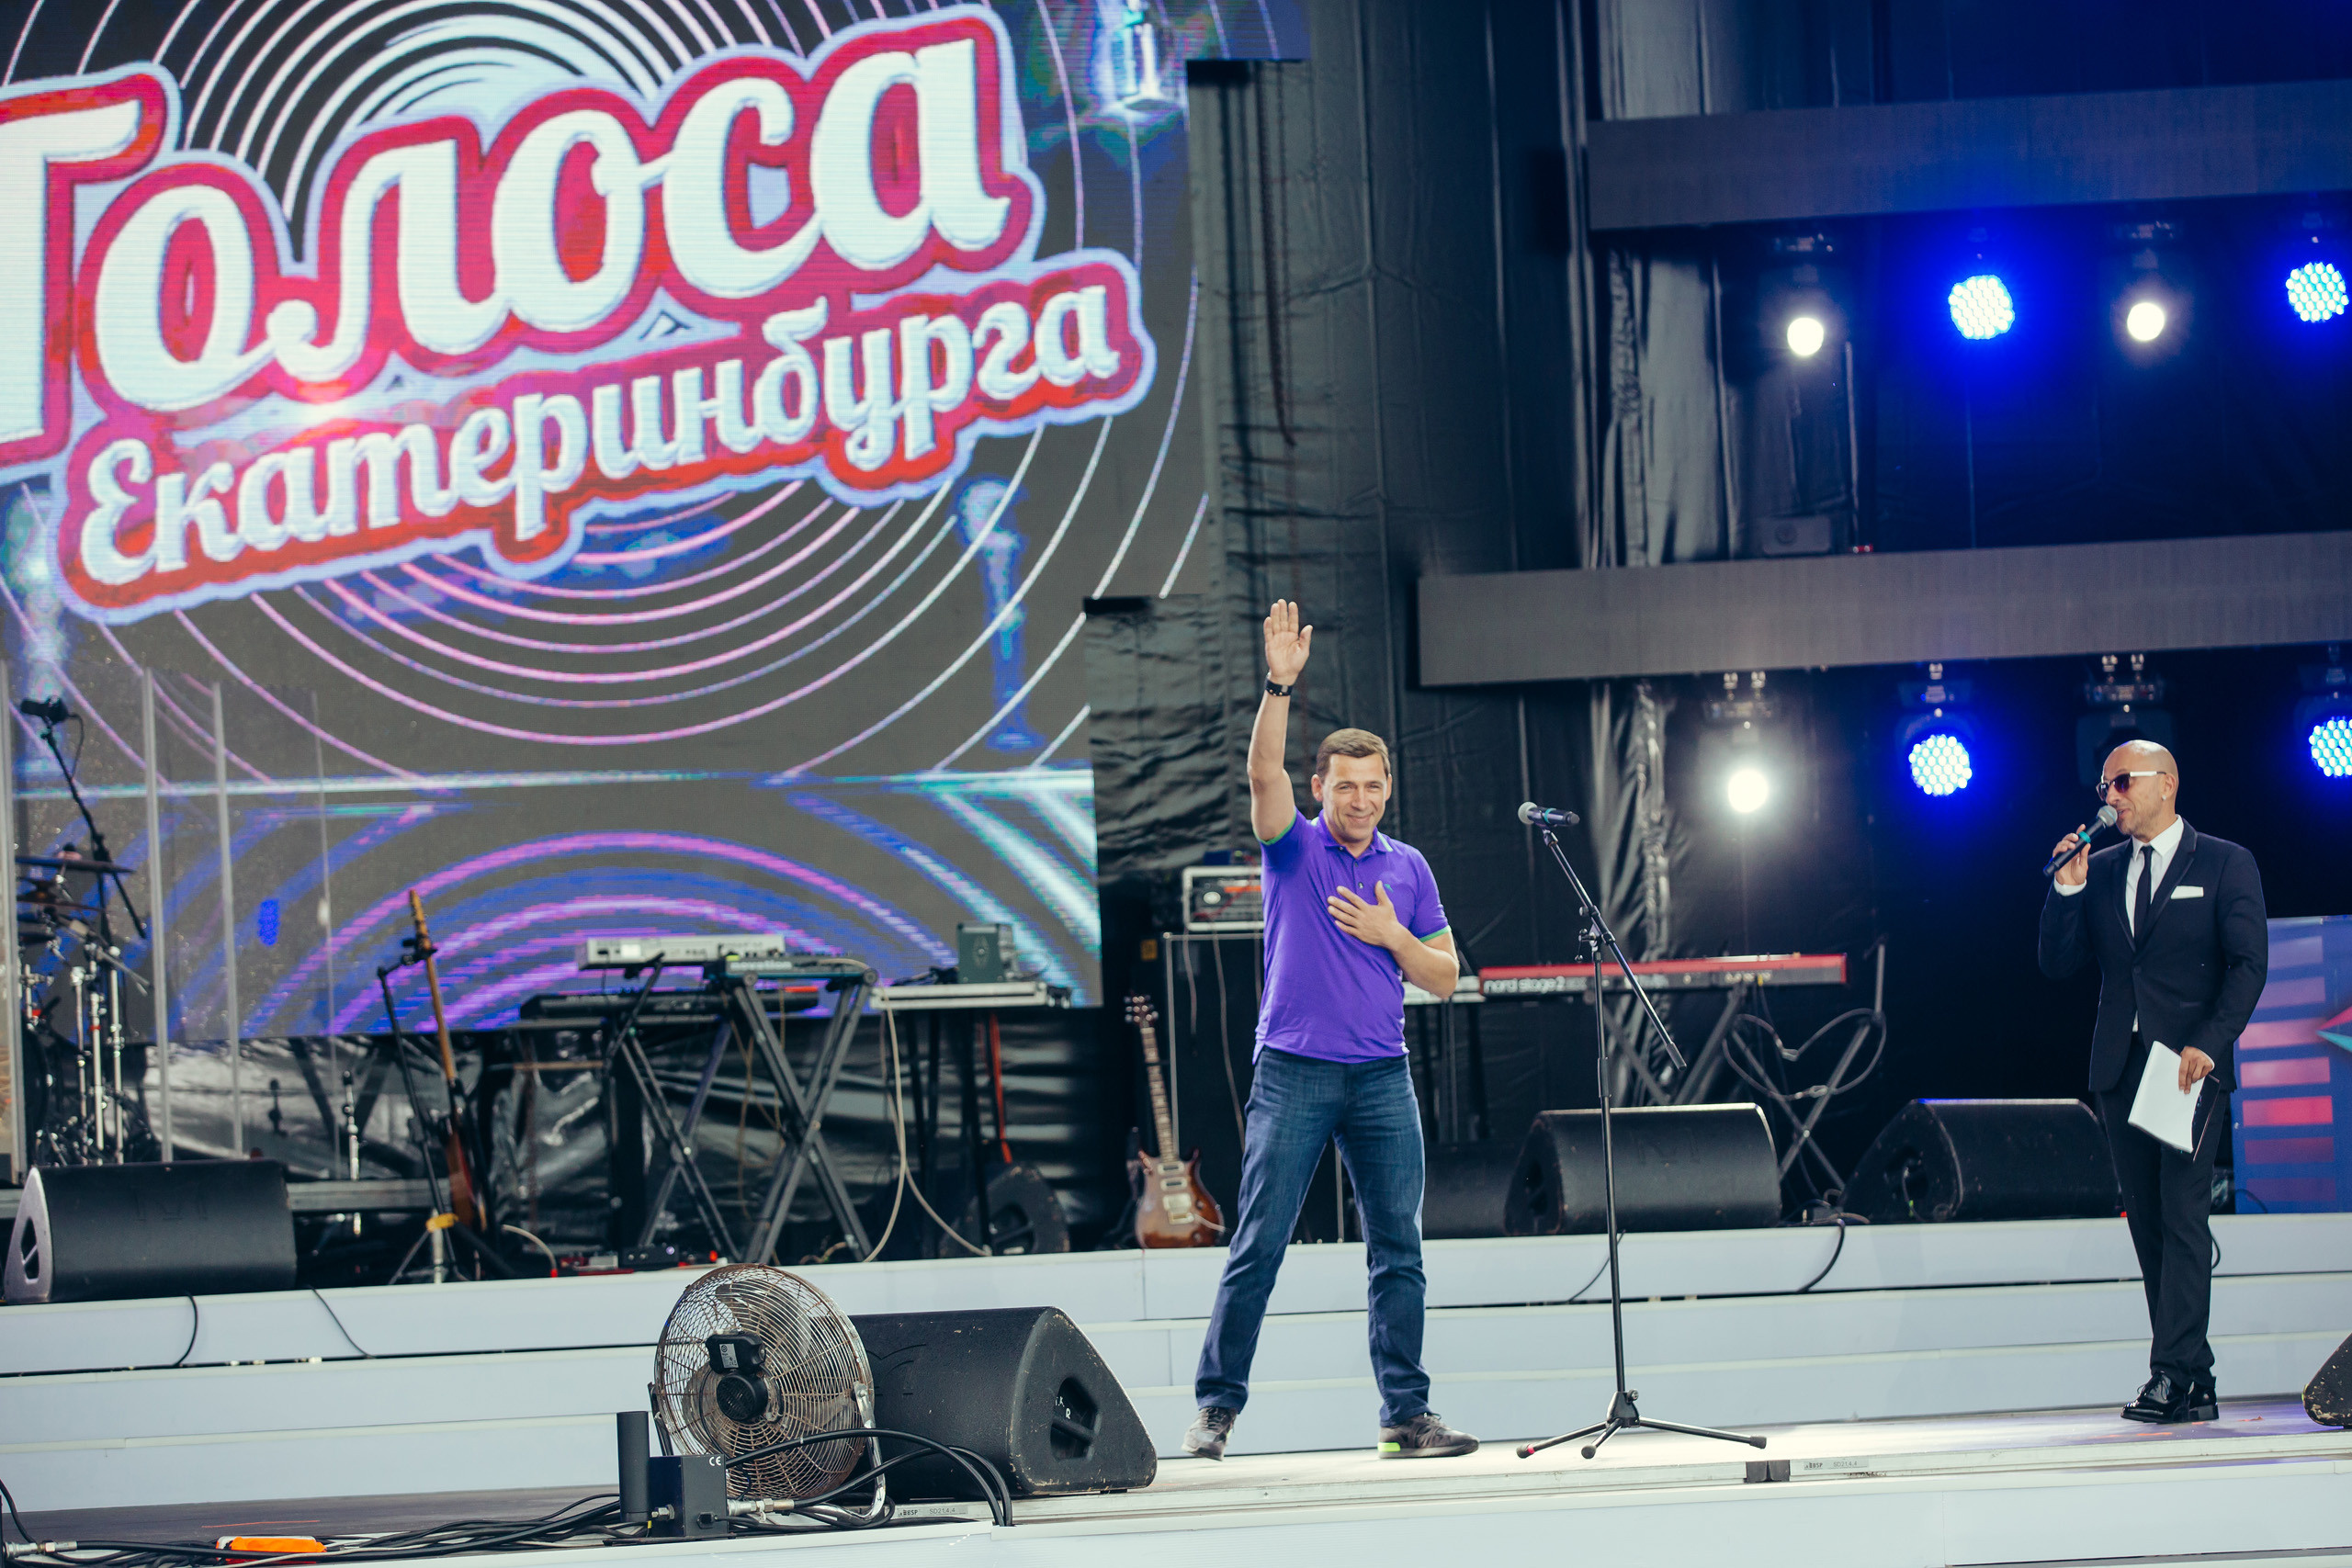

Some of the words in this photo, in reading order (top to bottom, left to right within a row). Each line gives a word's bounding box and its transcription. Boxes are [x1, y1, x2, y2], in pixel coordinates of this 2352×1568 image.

[0, 38, 1012, 446] Голоса
[79, 284, 1121, 586] Екатеринбурга
[709, 1457, 721, 1466] CE
